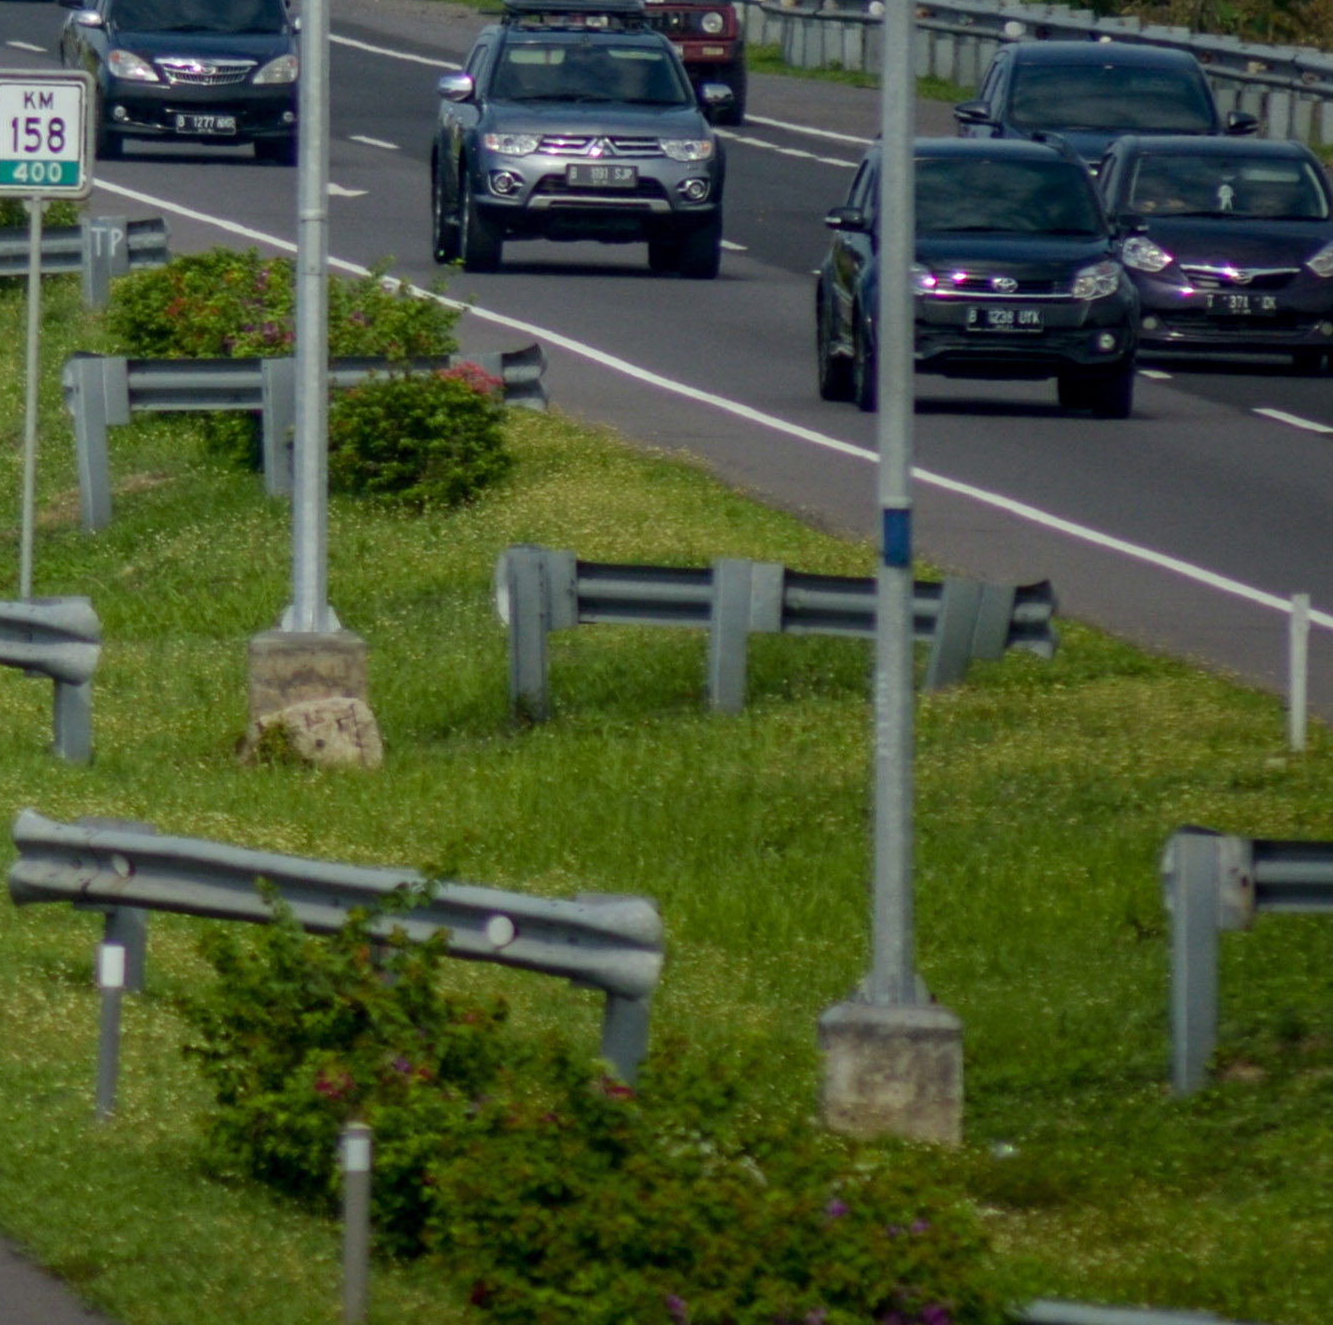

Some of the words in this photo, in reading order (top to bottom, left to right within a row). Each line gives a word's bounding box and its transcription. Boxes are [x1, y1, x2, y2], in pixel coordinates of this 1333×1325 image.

[23, 91, 54, 110] KM
[193, 116, 215, 128] 1277
[11, 116, 66, 154] 158
[12, 161, 63, 183] 400
[91, 227, 123, 256] TP
[969, 309, 978, 324] B
